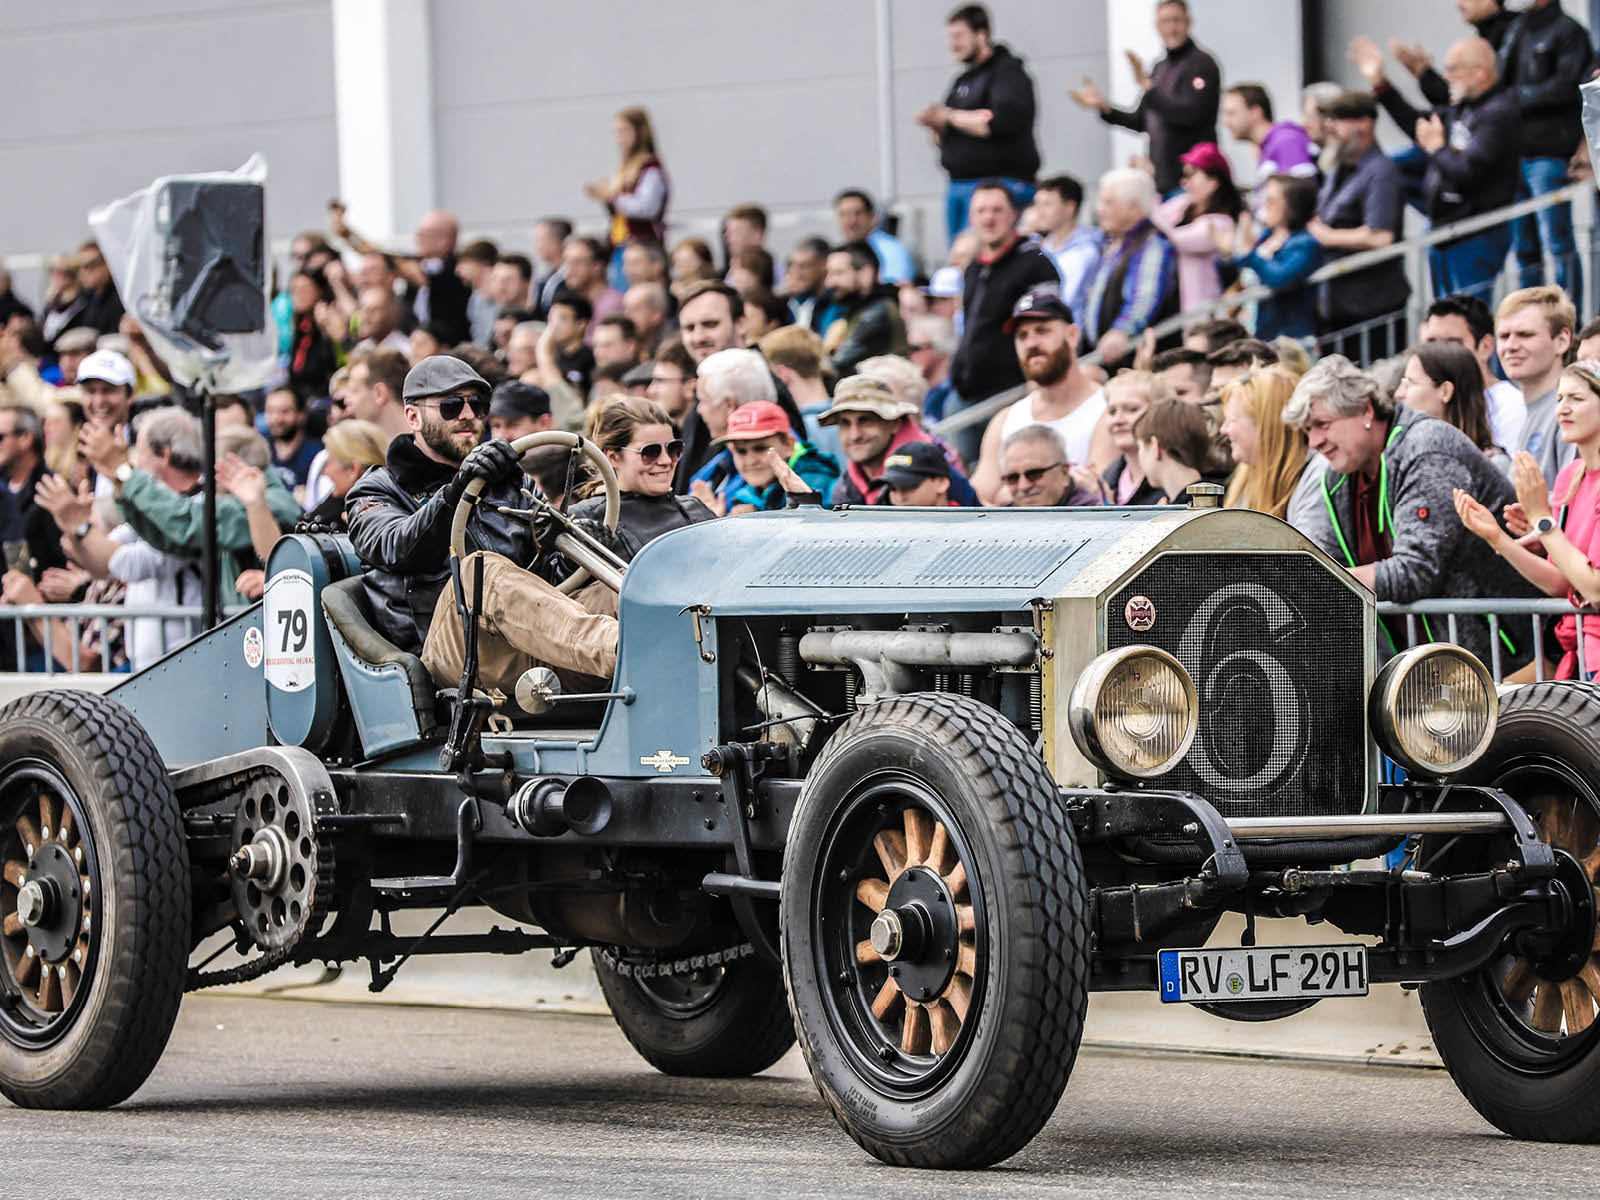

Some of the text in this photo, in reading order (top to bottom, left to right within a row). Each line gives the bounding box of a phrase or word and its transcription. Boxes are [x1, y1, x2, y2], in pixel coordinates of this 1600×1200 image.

[277, 608, 308, 653] 79
[1176, 582, 1311, 803] 6
[1166, 981, 1174, 993] D
[1181, 951, 1365, 994] RV LF 29H
